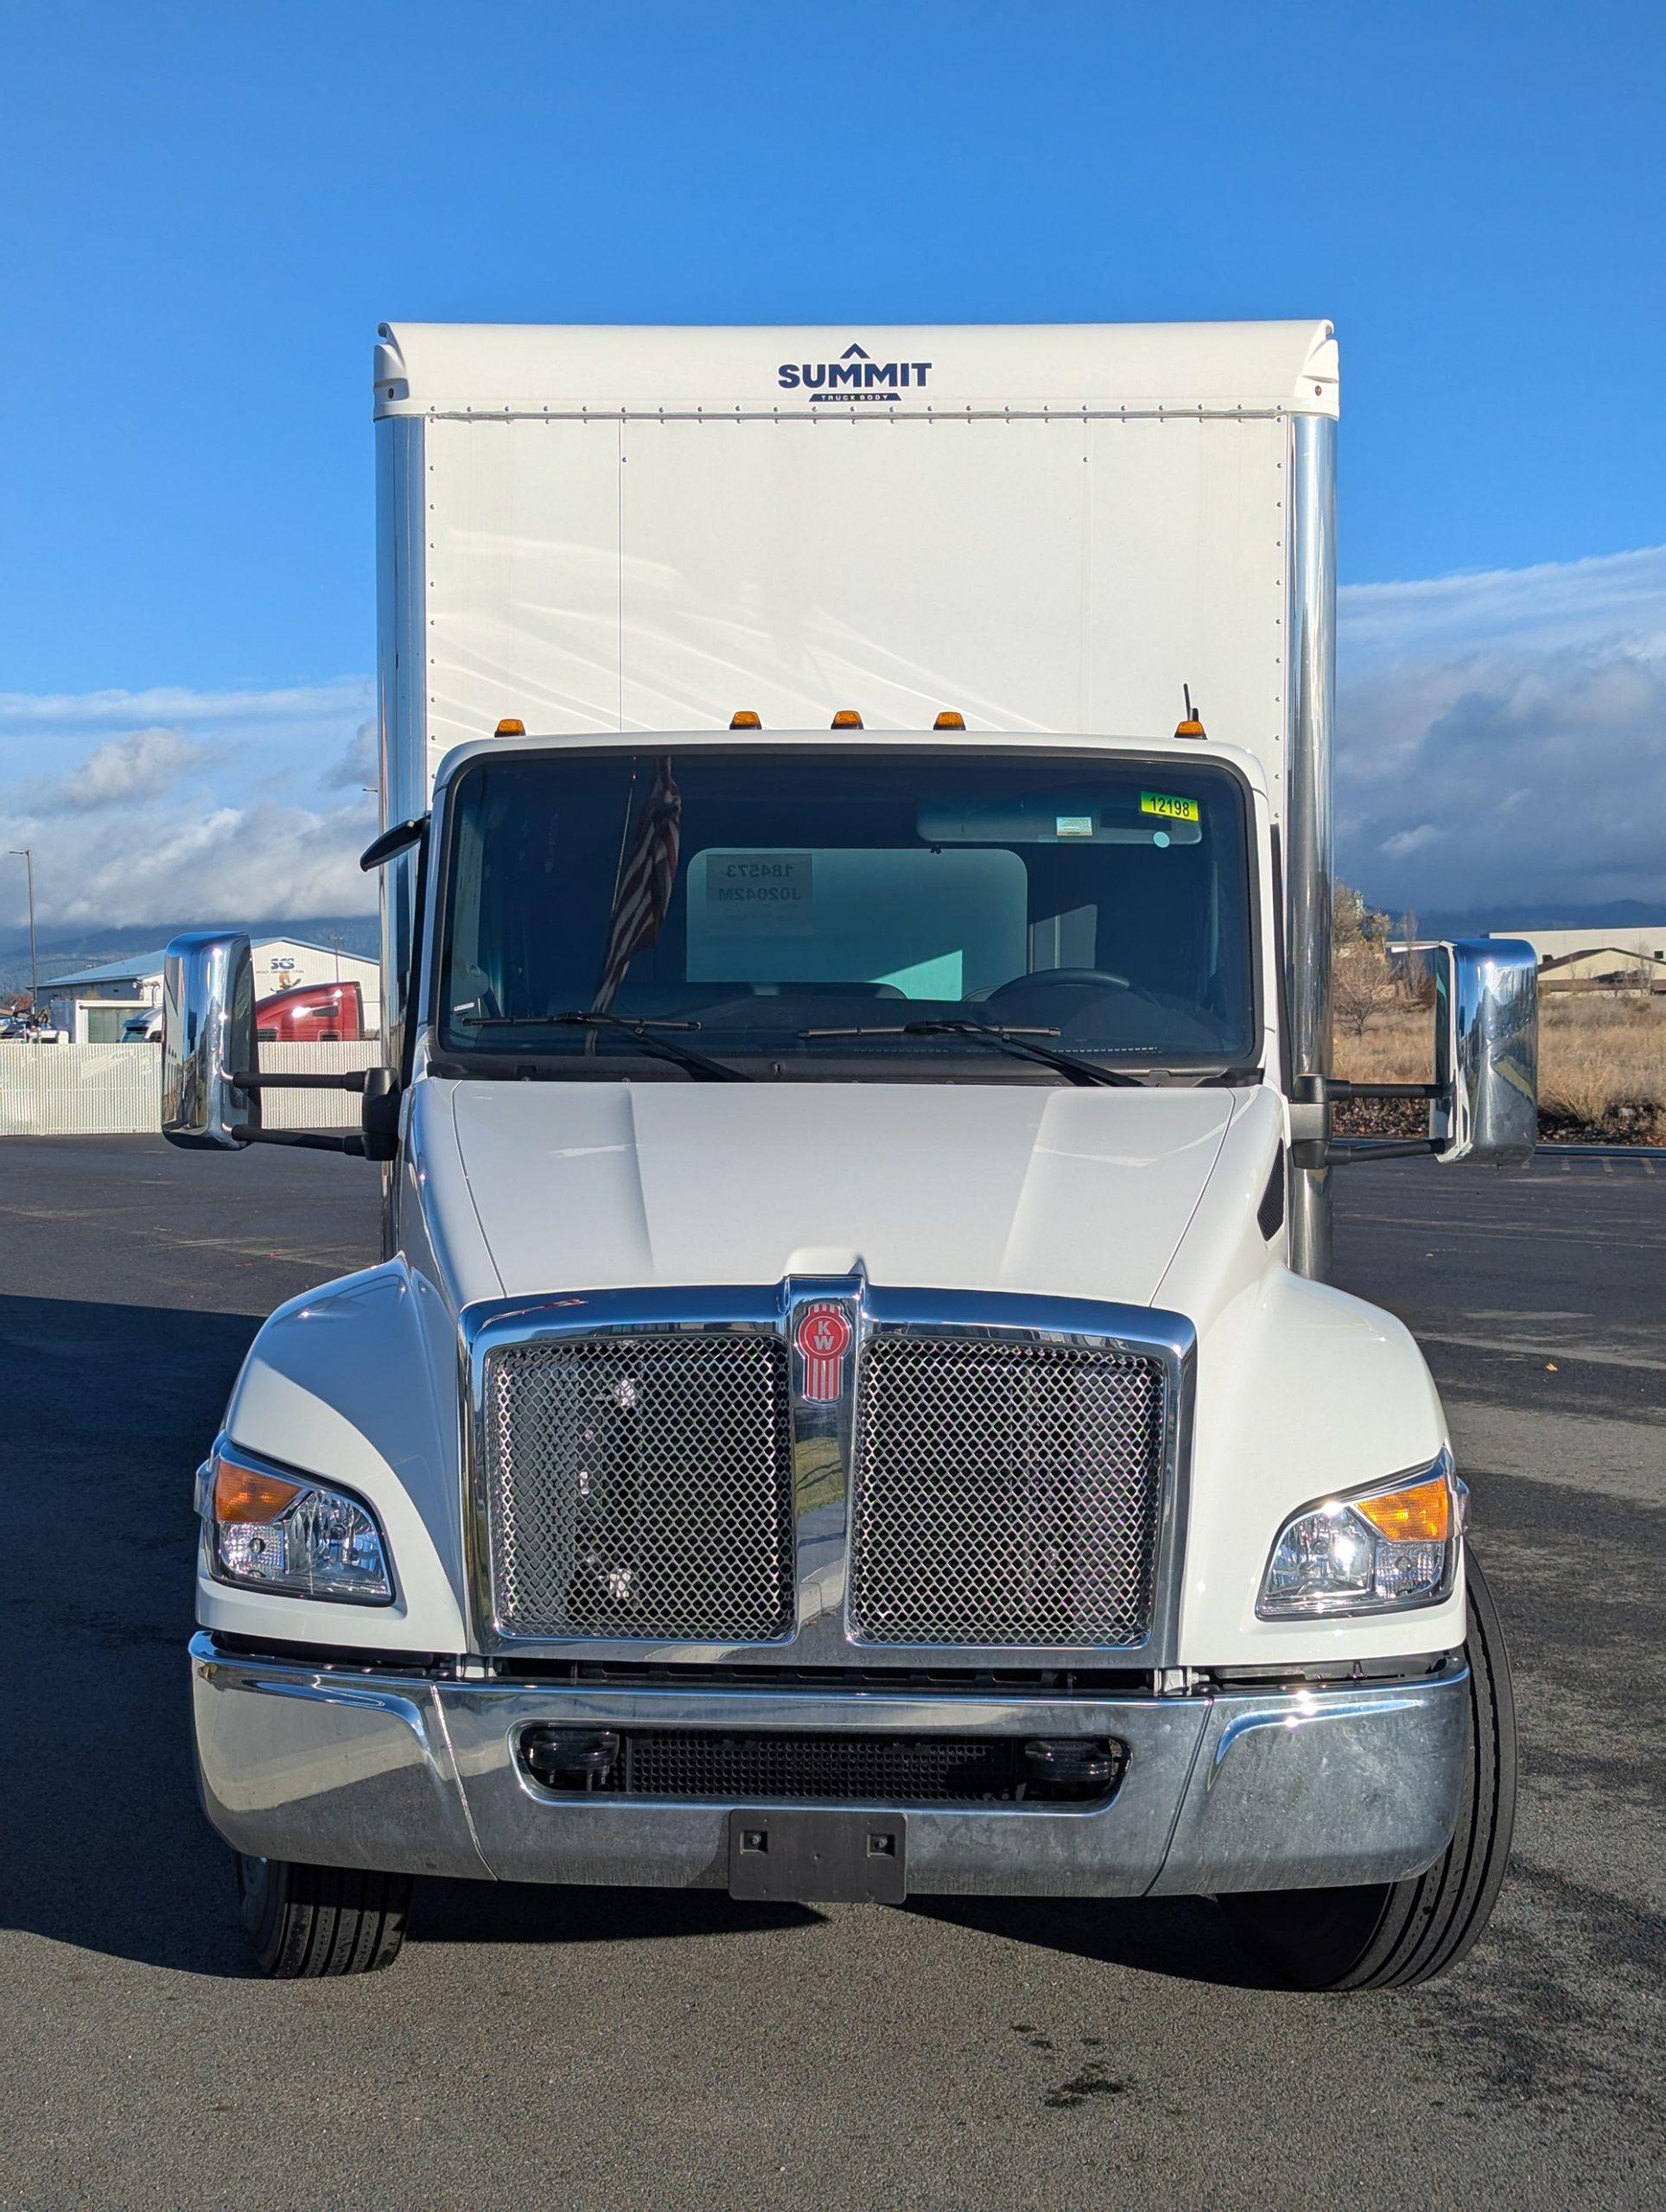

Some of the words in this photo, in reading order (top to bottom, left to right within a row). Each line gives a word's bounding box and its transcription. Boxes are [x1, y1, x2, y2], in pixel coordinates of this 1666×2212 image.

[778, 363, 932, 388] SUMMIT
[1150, 797, 1190, 817] 12198
[270, 957, 295, 969] SCS
